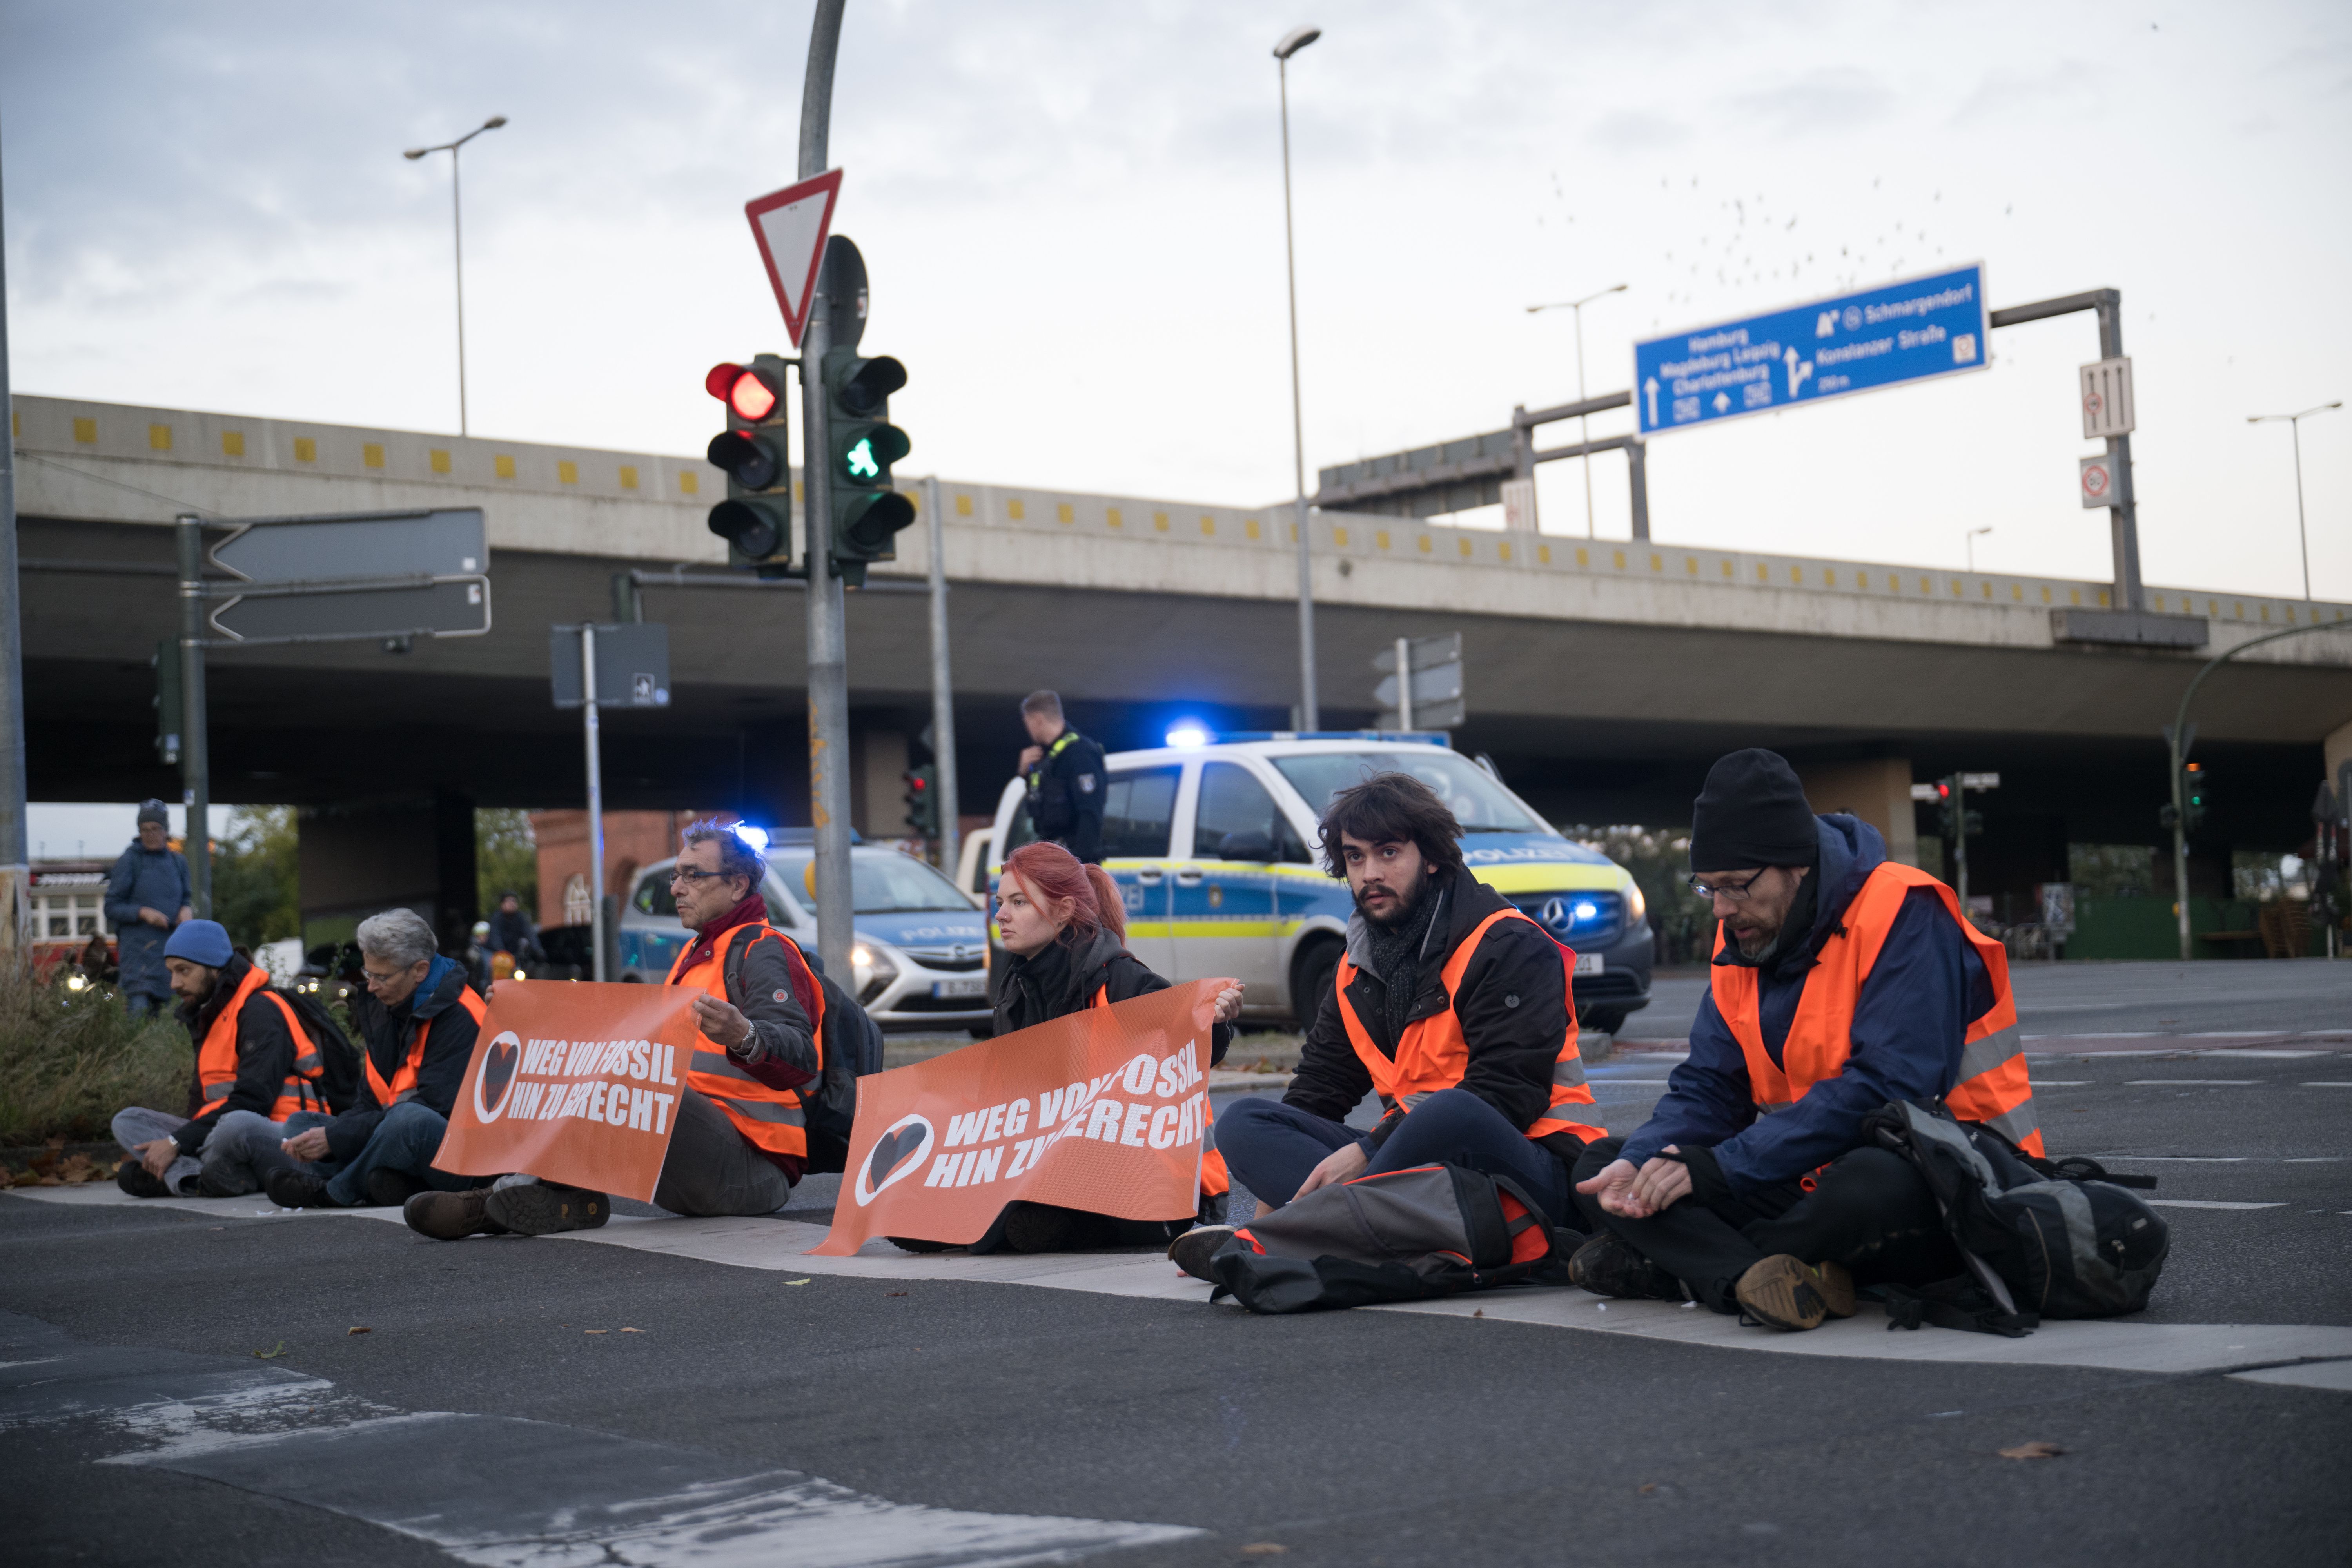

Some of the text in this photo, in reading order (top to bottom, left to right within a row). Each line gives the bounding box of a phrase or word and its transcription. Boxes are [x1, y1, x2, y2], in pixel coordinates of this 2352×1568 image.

[1864, 283, 1973, 325] Schmargendorf
[1660, 339, 1781, 379] Magdeburg Leipzig
[1688, 328, 1749, 353] Hamburg
[1815, 324, 1947, 367] Konstanzer Straße
[1672, 363, 1770, 397] Charlottenburg
[521, 1039, 677, 1085] WEG VON FOSSIL
[508, 1080, 674, 1135] HIN ZU GERECHT
[944, 1038, 1202, 1147] WEG VON FOSSIL
[924, 1145, 1004, 1187] HIN
[1005, 1131, 1057, 1179] ZU
